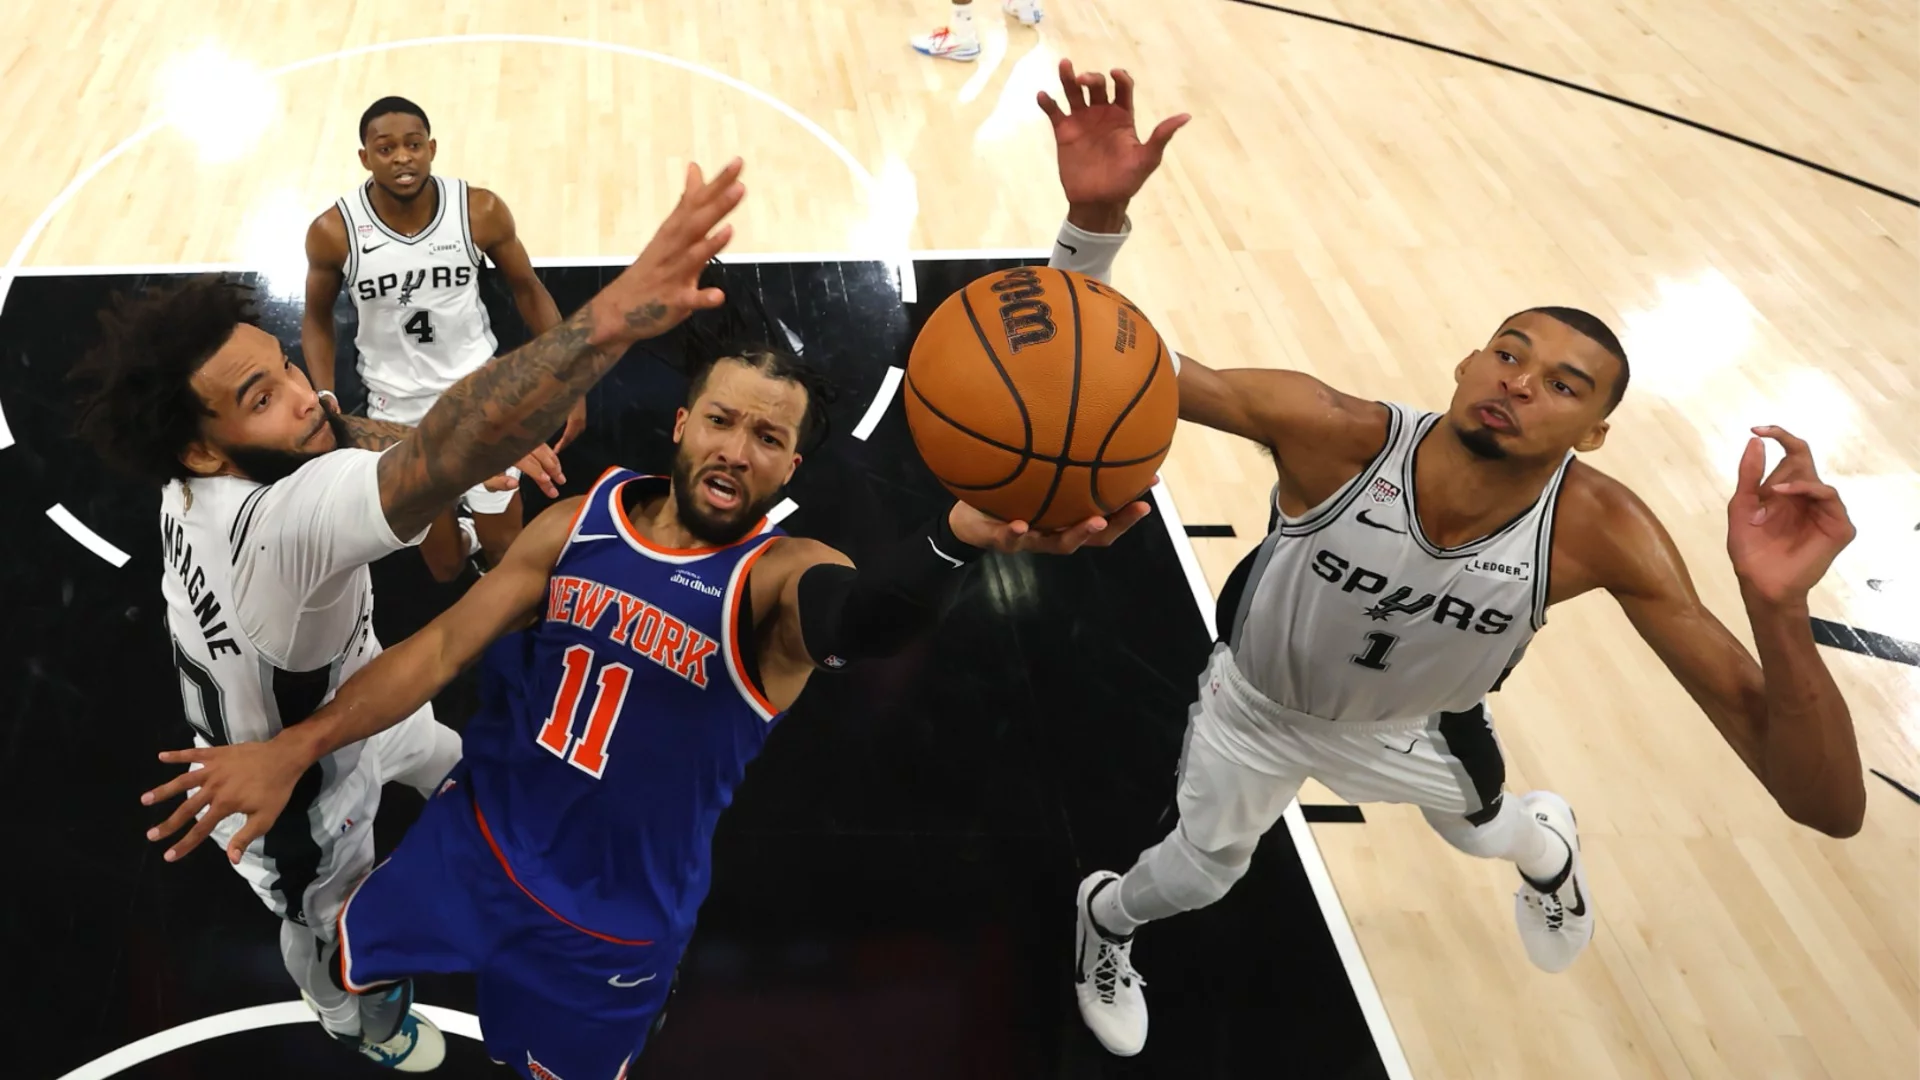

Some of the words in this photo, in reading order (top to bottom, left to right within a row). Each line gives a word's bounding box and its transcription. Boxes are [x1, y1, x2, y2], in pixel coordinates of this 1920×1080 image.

[358, 266, 471, 307] SPURS
[403, 309, 435, 345] 4
[670, 573, 690, 587] abu
[689, 579, 723, 598] dhabi
[1474, 559, 1522, 577] LEDGER
[1311, 550, 1514, 635] SPURS
[547, 576, 615, 631] NEW
[608, 590, 721, 691] YORK
[1350, 630, 1400, 672] 1
[535, 643, 634, 781] 11
